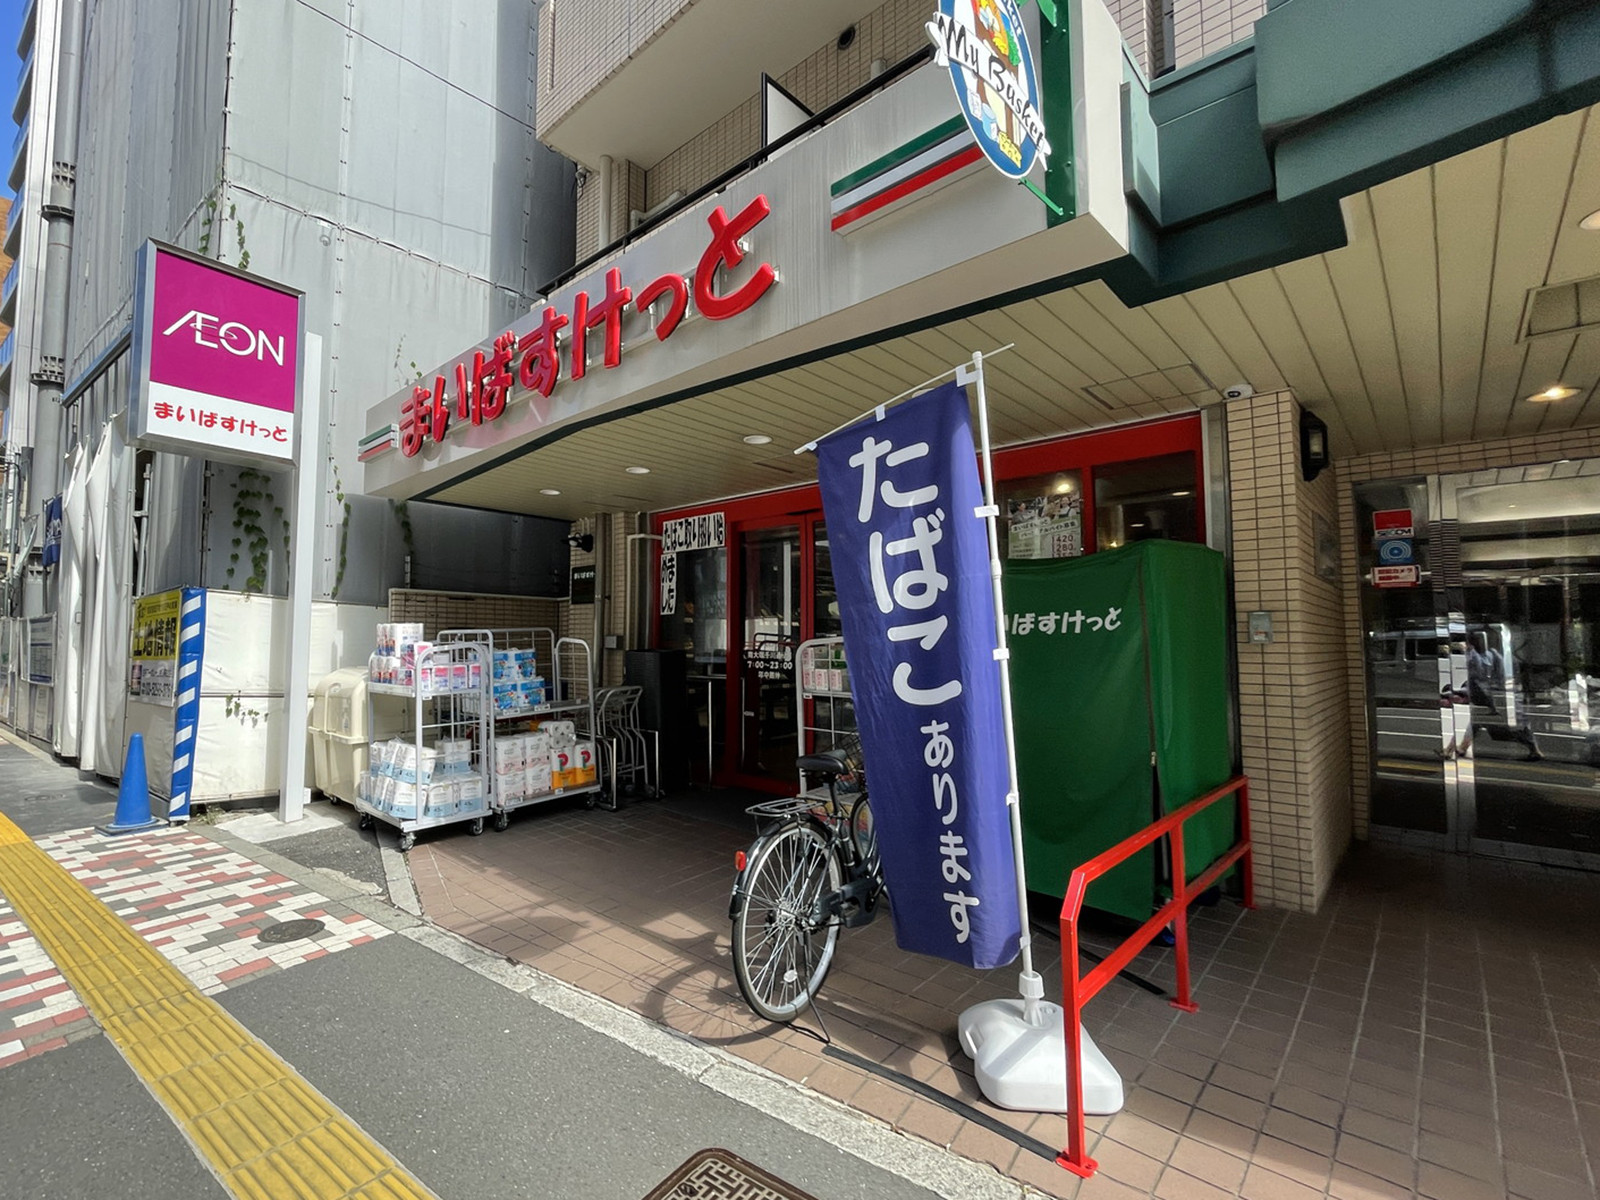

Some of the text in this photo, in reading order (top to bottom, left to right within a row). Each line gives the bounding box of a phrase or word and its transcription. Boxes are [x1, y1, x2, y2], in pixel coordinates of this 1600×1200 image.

[938, 15, 980, 75] My
[399, 193, 777, 458] まいばすけっと
[153, 401, 288, 443] まいばすけっと
